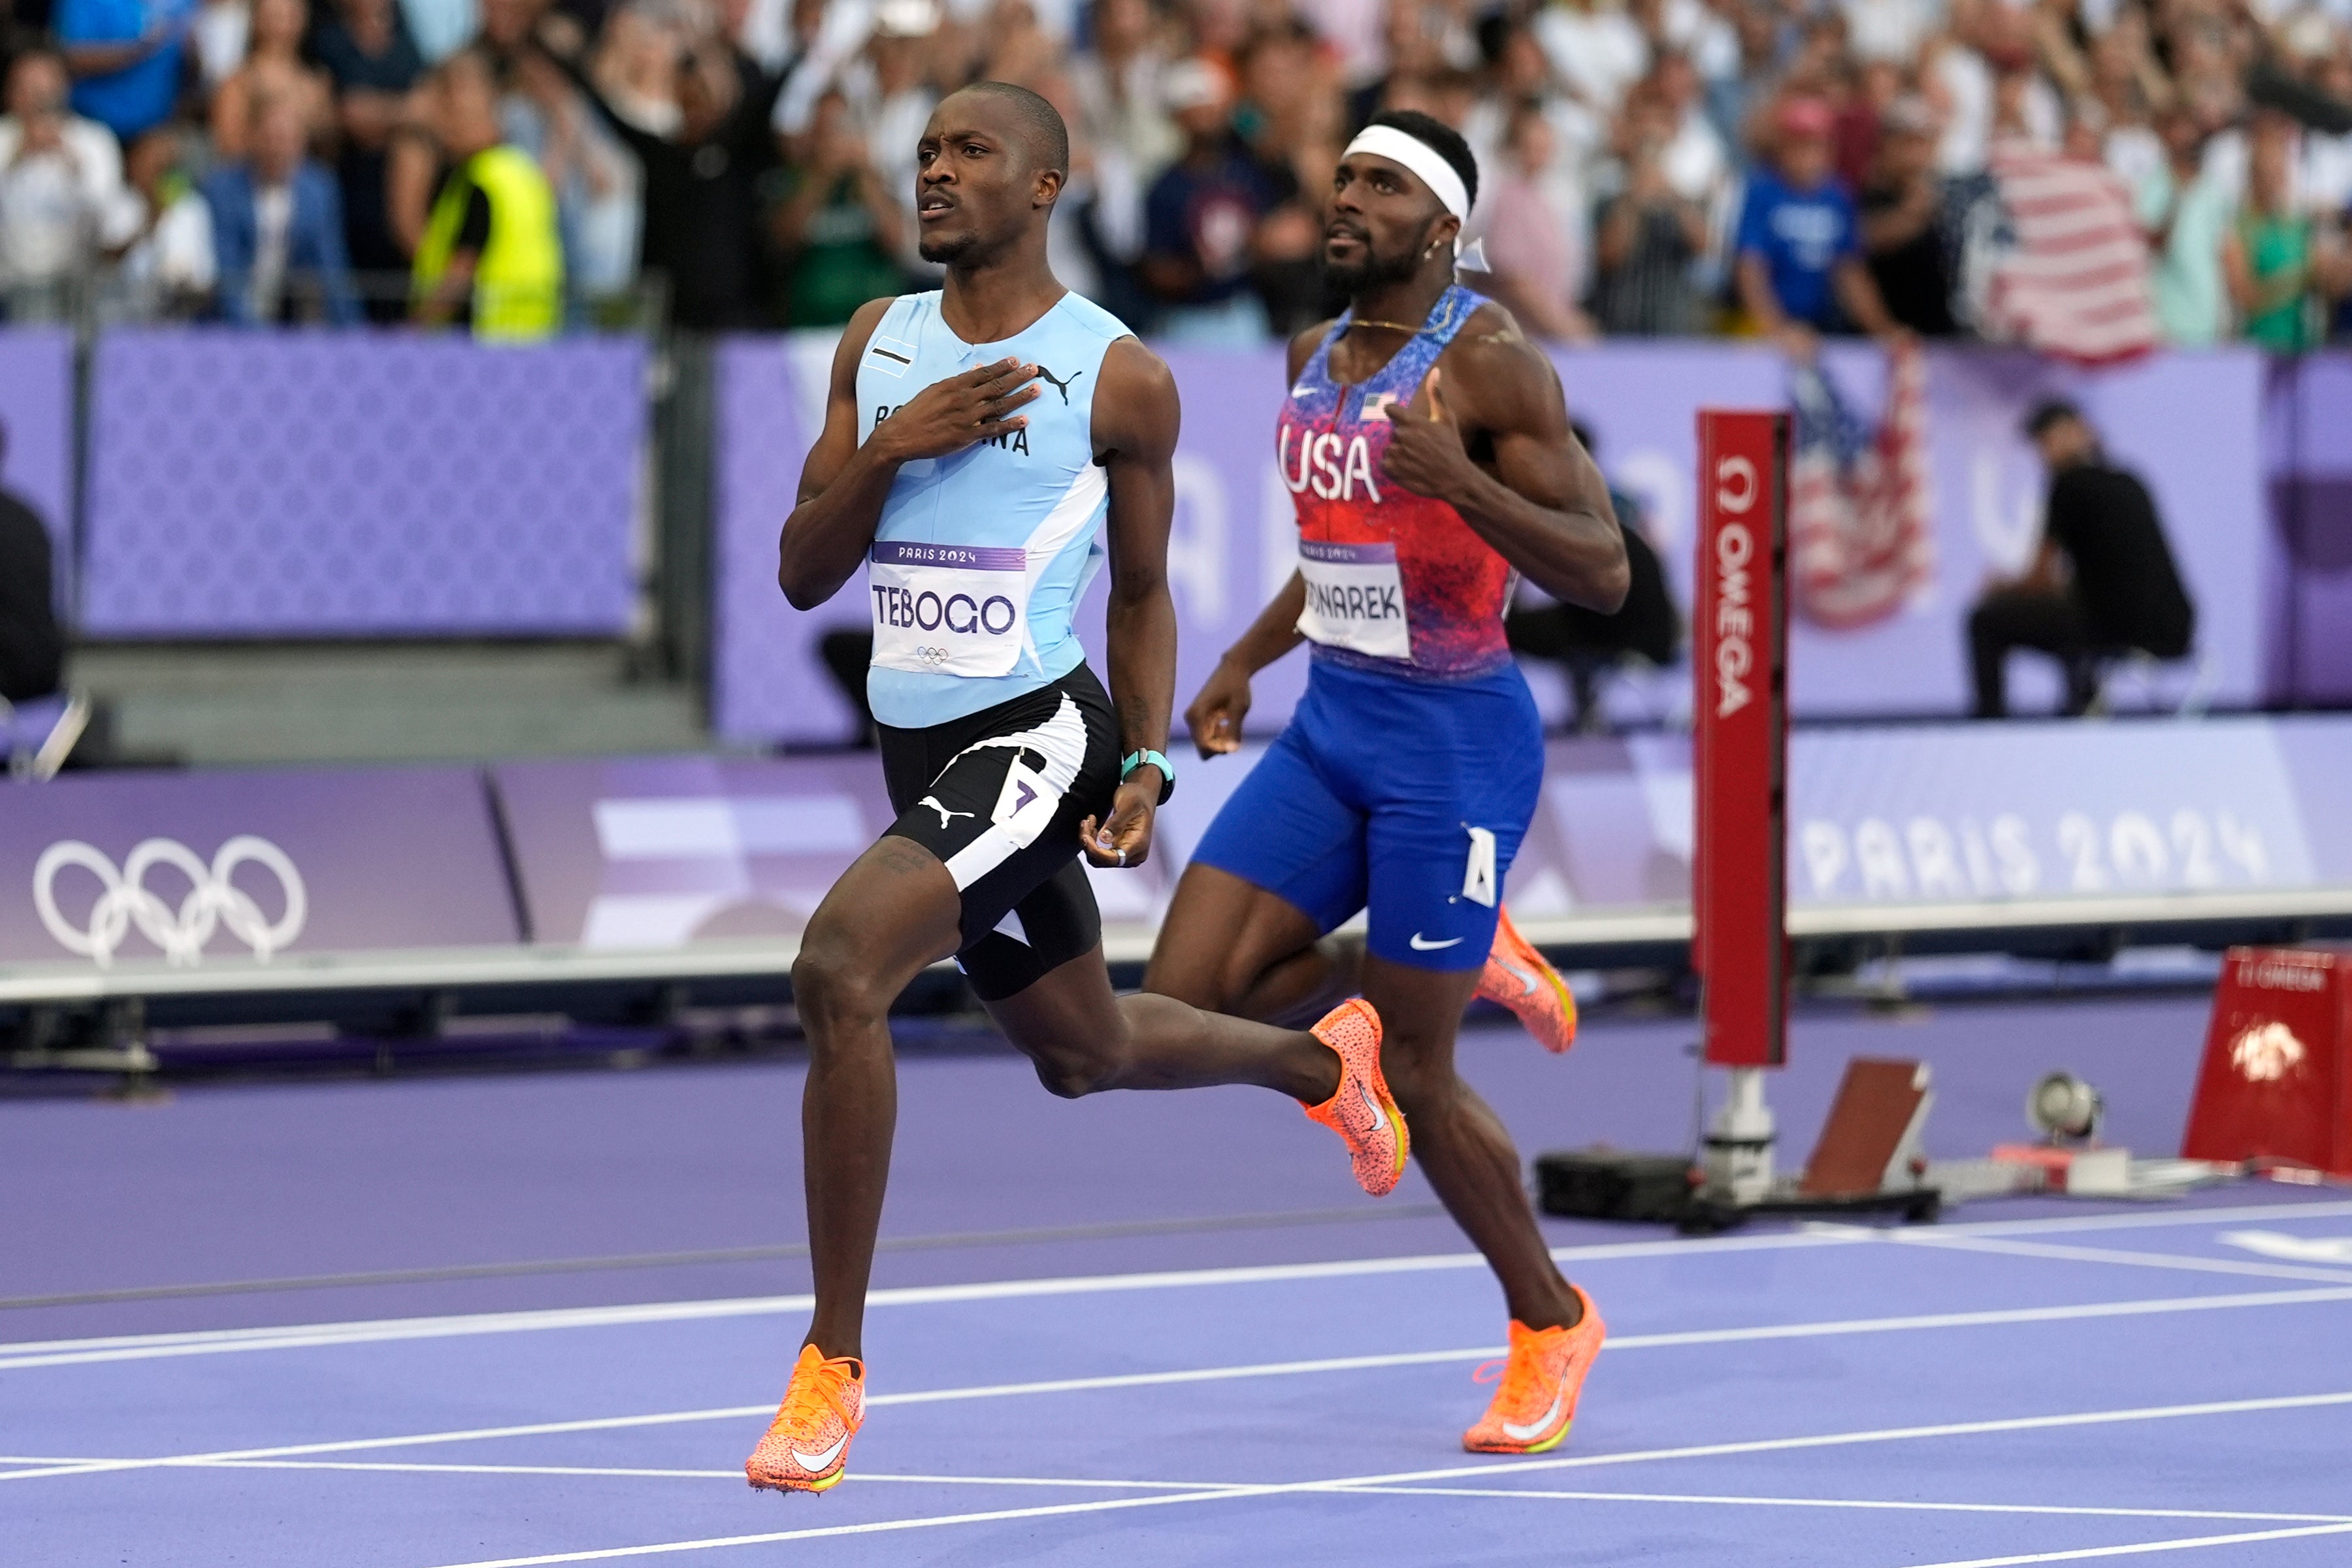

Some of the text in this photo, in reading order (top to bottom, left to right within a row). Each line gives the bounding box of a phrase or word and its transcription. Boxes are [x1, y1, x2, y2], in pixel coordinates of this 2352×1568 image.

[1279, 424, 1382, 504] USA
[939, 549, 976, 563] 2024
[872, 584, 1016, 636] TEBOGO
[1716, 523, 1754, 719] OMEGA
[2058, 808, 2271, 892] 2024
